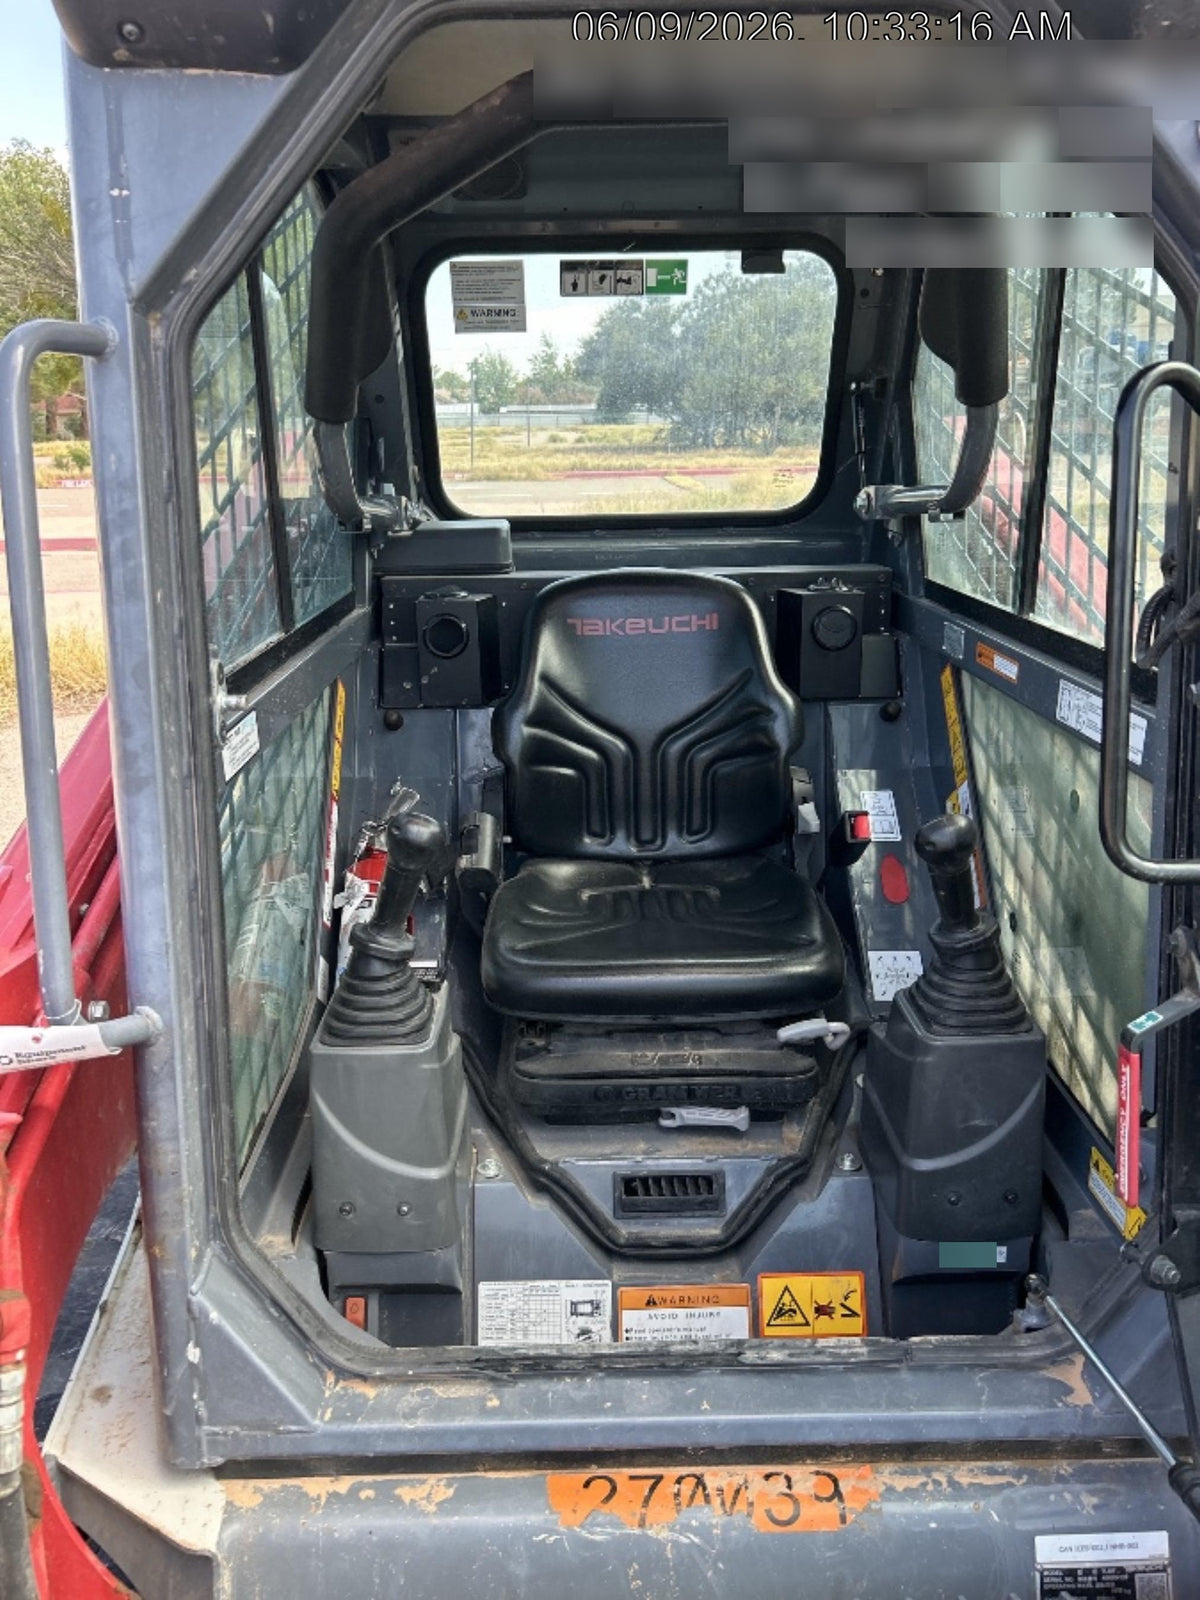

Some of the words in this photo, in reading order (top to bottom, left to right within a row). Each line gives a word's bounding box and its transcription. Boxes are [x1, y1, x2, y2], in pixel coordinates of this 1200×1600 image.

[567, 613, 719, 636] TAKEUCHI
[658, 1294, 720, 1306] WARNING
[648, 1312, 678, 1320] AVOID
[685, 1311, 721, 1320] INJURY
